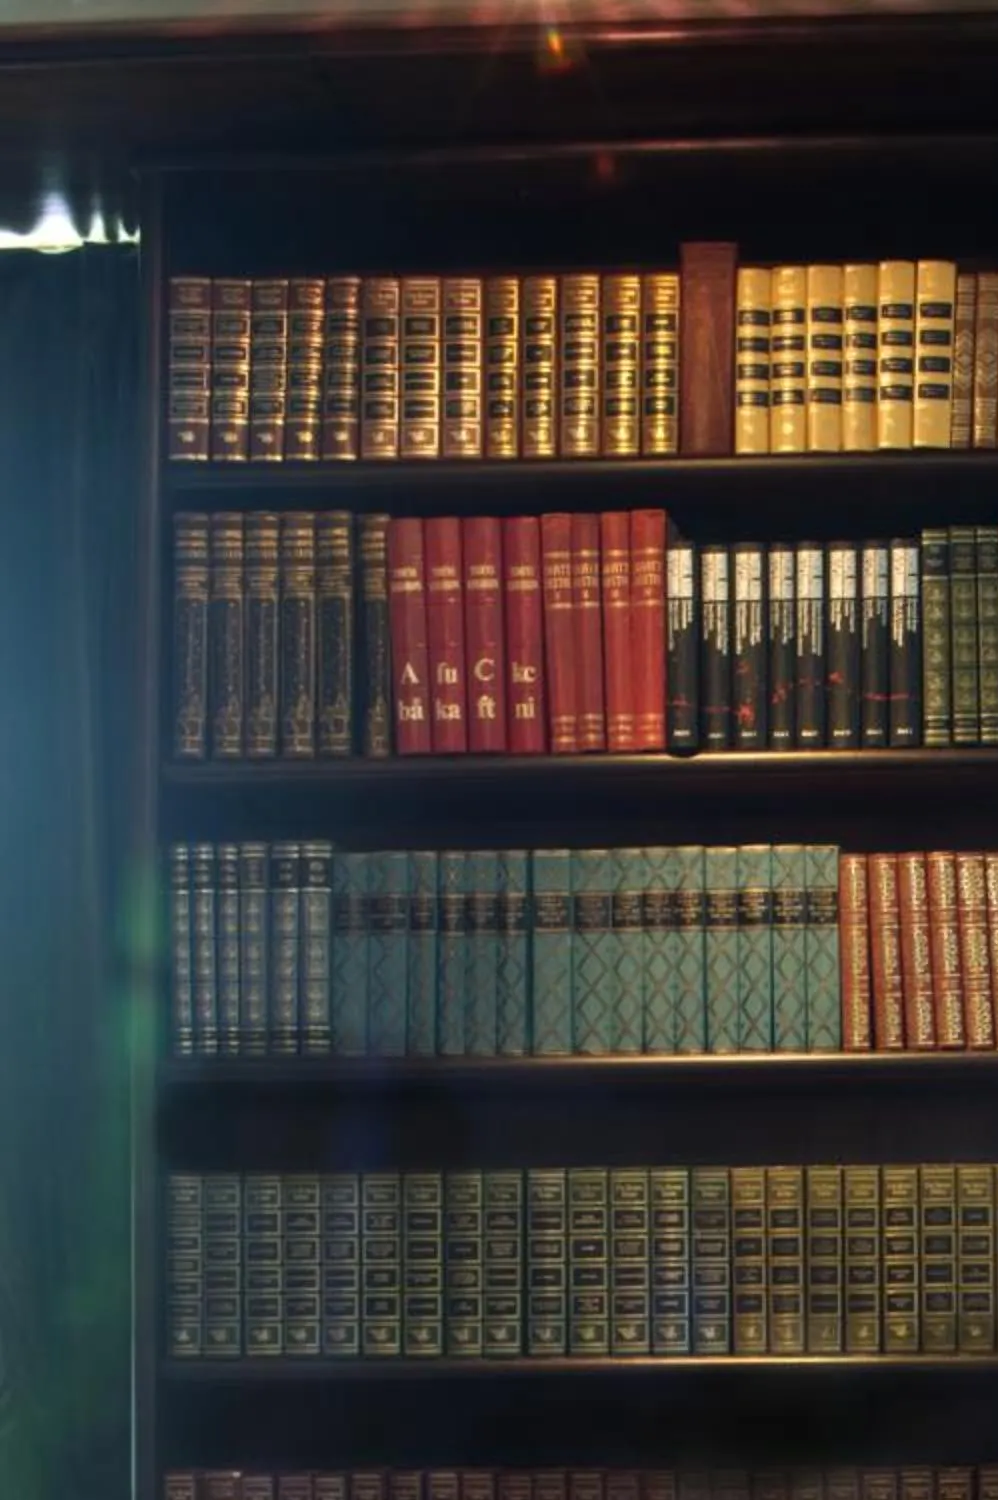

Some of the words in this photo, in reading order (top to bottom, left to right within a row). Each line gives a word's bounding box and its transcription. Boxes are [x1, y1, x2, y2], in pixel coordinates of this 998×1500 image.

[401, 661, 420, 685] A
[473, 657, 495, 681] C
[435, 697, 461, 721] ka
